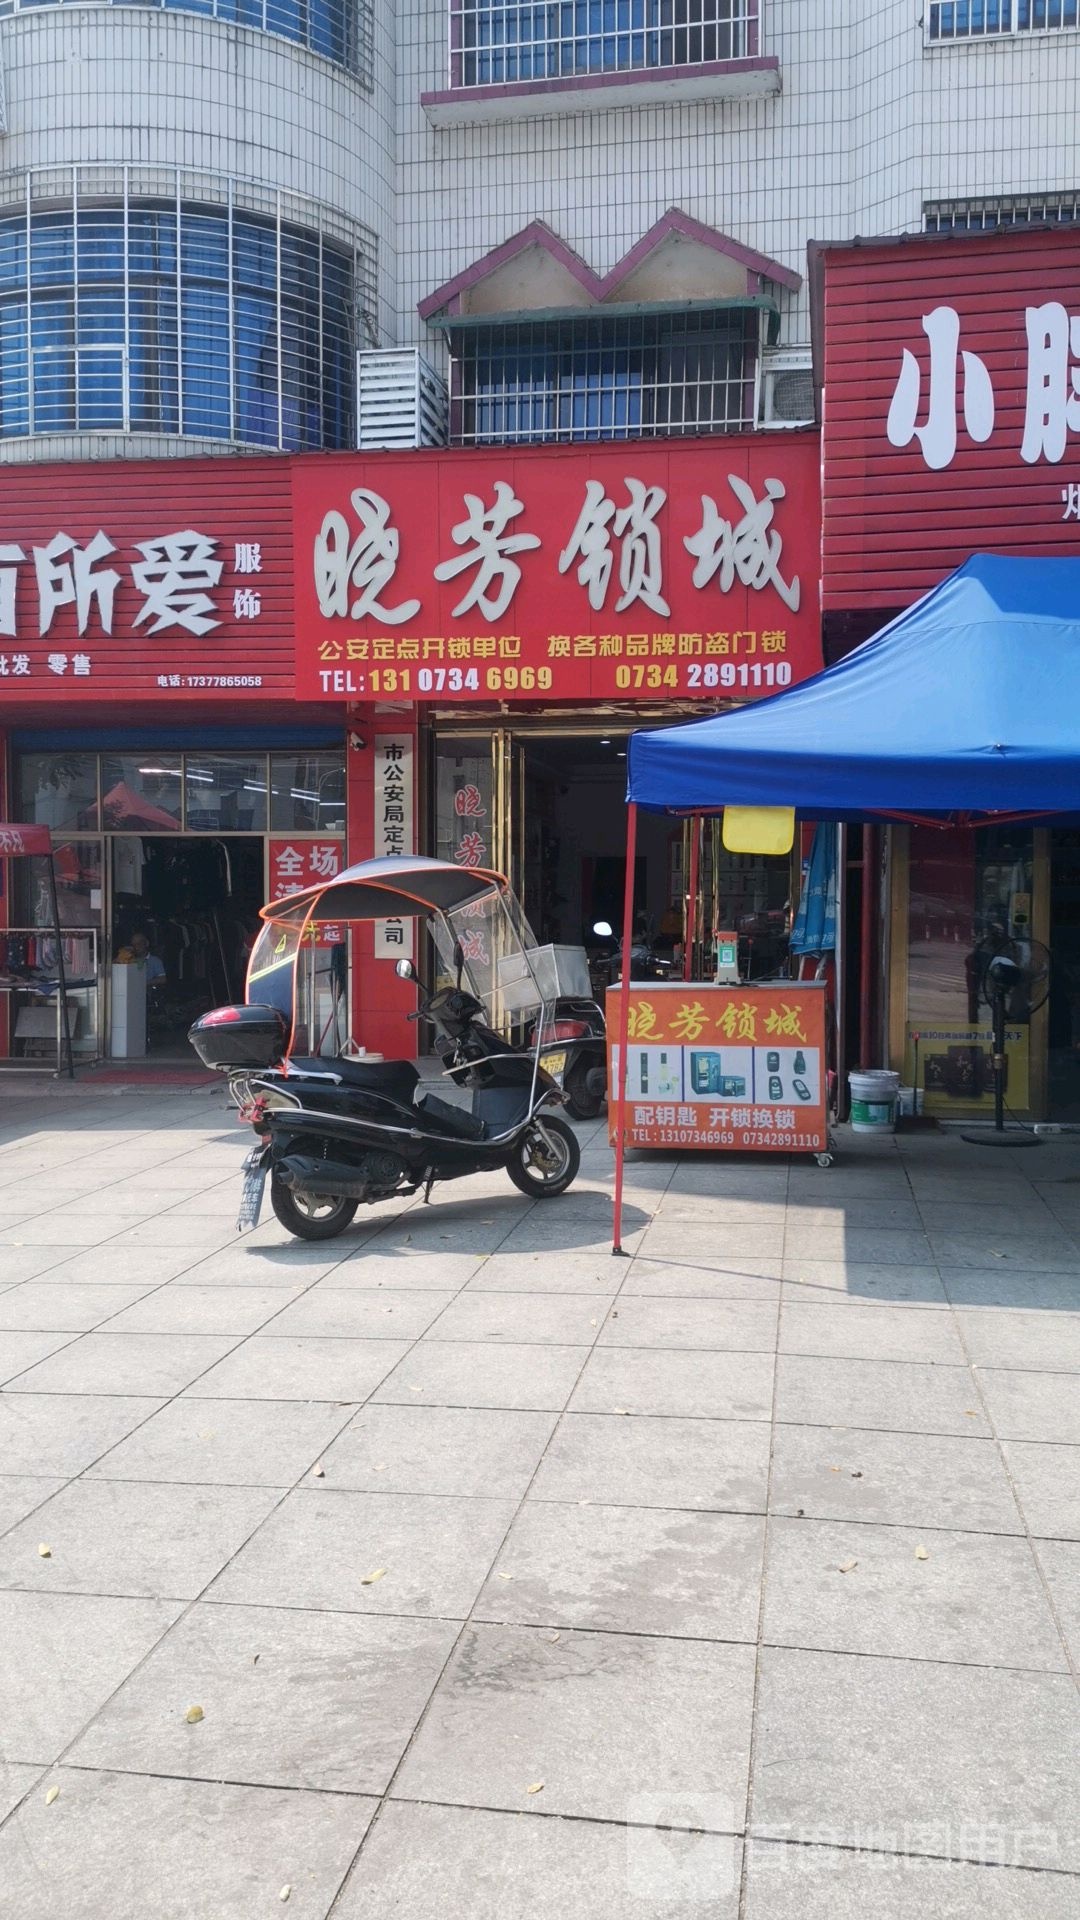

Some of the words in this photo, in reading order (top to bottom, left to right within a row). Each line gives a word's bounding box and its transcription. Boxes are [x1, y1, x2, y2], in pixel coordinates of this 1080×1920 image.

[314, 474, 800, 625] 晓芳锁城
[233, 543, 262, 619] 服饰
[318, 637, 521, 660] 公安定点开锁单位
[548, 630, 787, 657] 换各种品牌防盗门锁
[48, 654, 91, 675] 零售
[418, 667, 480, 692] 0734
[486, 666, 553, 690] 6969
[616, 664, 679, 688] 0734
[687, 661, 792, 687] 2891110
[275, 845, 339, 876] 全场
[626, 1000, 808, 1042] 晓芳锁城
[633, 1105, 697, 1127] 配钥匙
[709, 1107, 797, 1130] 开锁换锁
[743, 1131, 820, 1147] 07342891110
